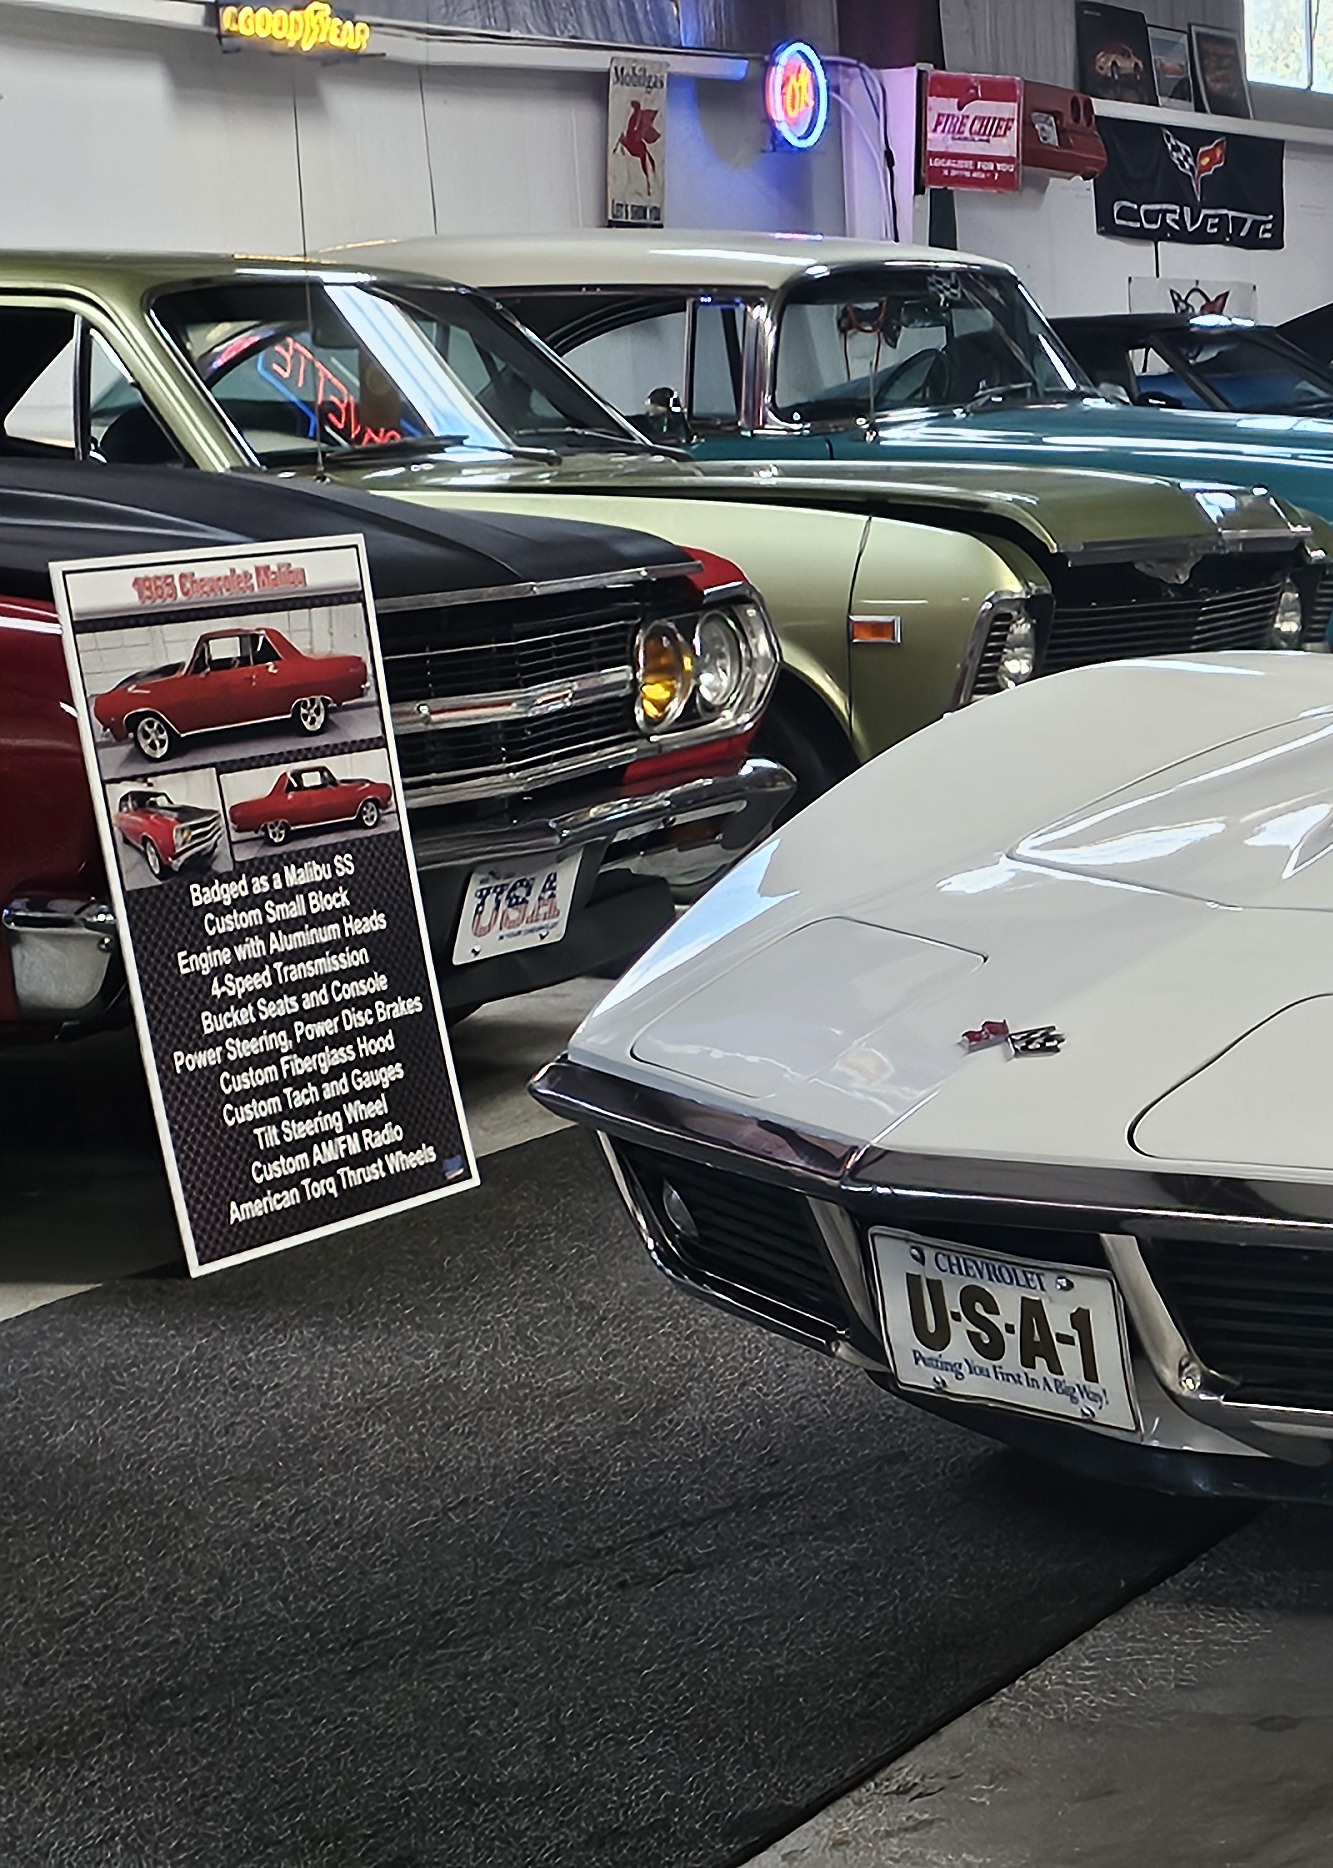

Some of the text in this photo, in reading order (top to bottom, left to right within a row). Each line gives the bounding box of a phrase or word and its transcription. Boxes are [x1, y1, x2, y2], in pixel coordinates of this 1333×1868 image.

[238, 2, 369, 51] GOODYEAR
[932, 113, 1015, 138] FIRE CHIEF
[1113, 201, 1274, 238] CORVETTE
[133, 563, 307, 603] 1965 Chevrolet Malibu
[190, 853, 355, 906] Badged as a Malibu SS
[472, 872, 560, 937] USA
[204, 886, 350, 936] Custom Small Block
[177, 910, 387, 975] Engine with Aluminum Heads
[211, 947, 370, 999] 4-Speed Transmission
[201, 971, 388, 1035] Bucket Seats and Console
[173, 995, 423, 1073] Power Steering, Power Disc Brakes
[219, 1029, 395, 1095] Custom Fiberglass Hood
[223, 1061, 404, 1127] Custom Tach and Gauges
[253, 1093, 388, 1150] Tilt Steering Wheel
[251, 1121, 404, 1184] Custom AM/FM Radio
[229, 1187, 301, 1225] American
[301, 1176, 338, 1201] Torq
[338, 1158, 386, 1189] Thrust
[386, 1143, 437, 1173] Wheels
[934, 1252, 1048, 1292] CHEVROLET
[912, 1349, 1109, 1411] Putting You First In A Big Way!
